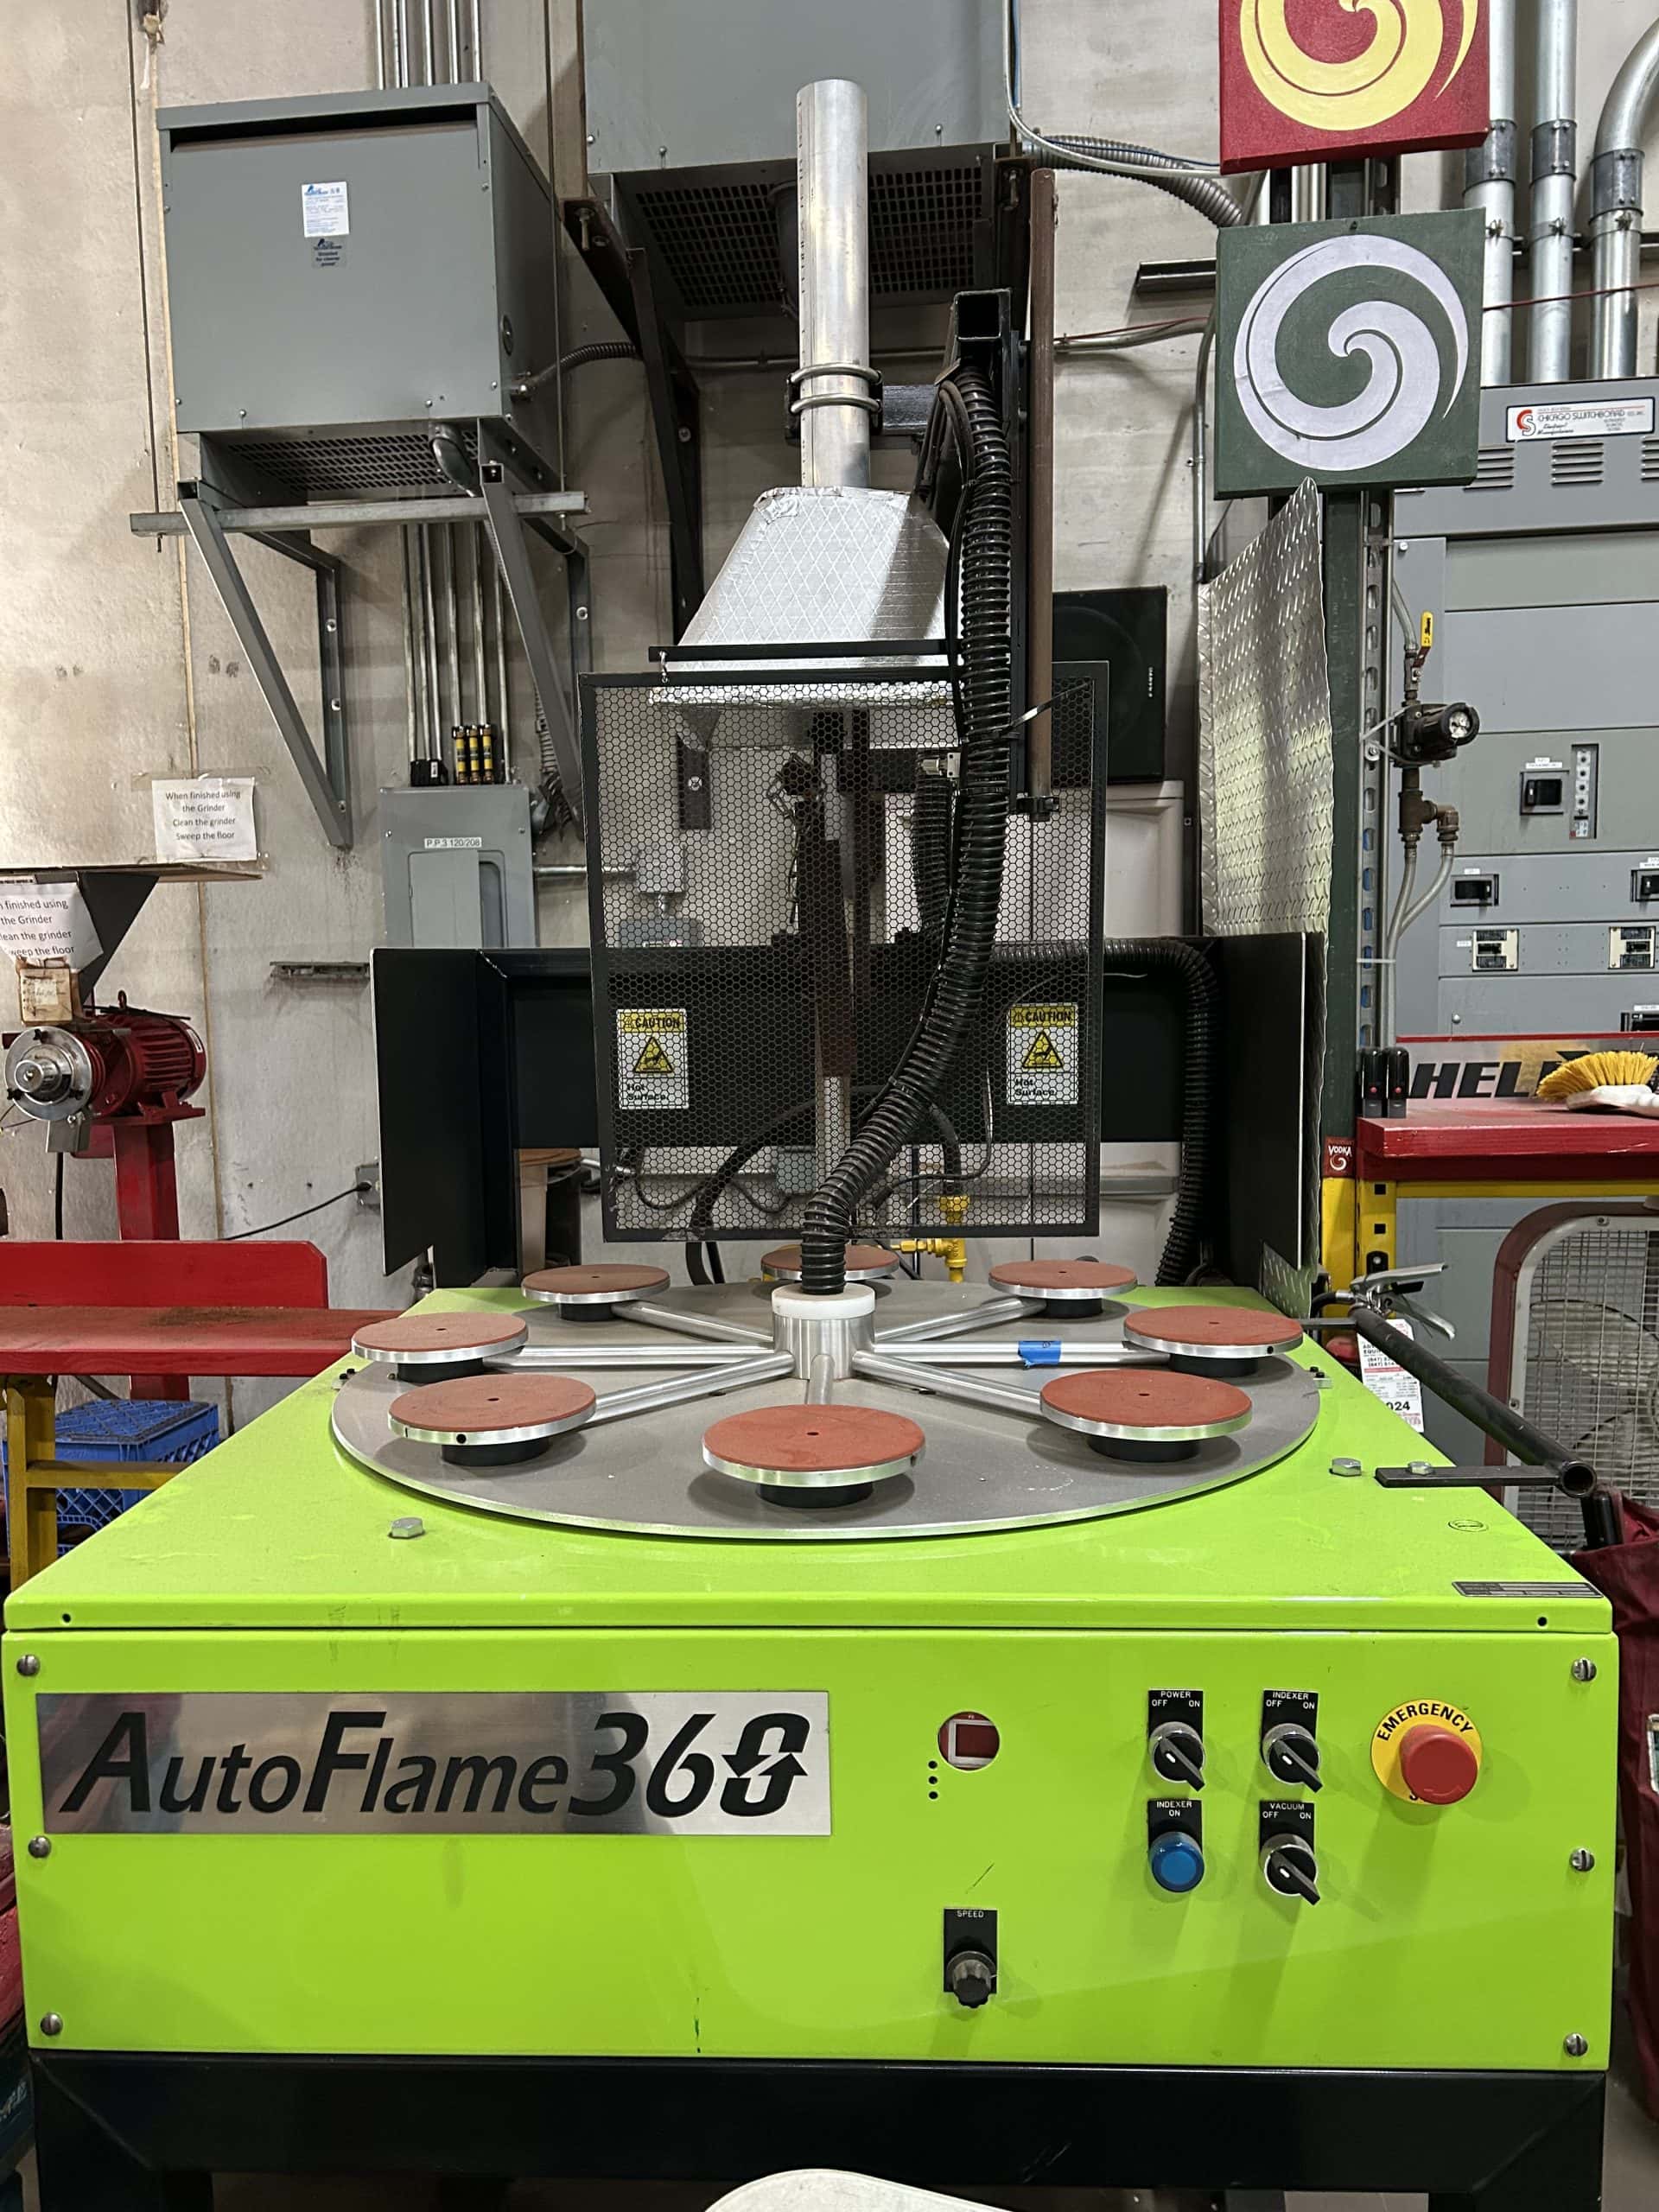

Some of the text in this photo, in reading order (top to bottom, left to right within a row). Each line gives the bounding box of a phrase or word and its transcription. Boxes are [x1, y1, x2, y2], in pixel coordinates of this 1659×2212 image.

[190, 791, 220, 799] finished
[221, 790, 241, 800] using
[182, 804, 226, 813] the Grinder
[210, 817, 236, 827] grinder
[4, 899, 41, 910] finished
[42, 899, 69, 910] using
[1, 915, 53, 925] the Grinder
[21, 931, 36, 941] the
[38, 930, 72, 942] grinder
[35, 947, 51, 956] the
[52, 945, 75, 955] floor
[1025, 1011, 1071, 1022] CAUTION
[635, 1017, 681, 1028] CAUTION
[1328, 1145, 1352, 1157] VODKA
[1160, 1690, 1192, 1699] POWER
[1272, 1691, 1309, 1700] INDEXER
[1266, 1699, 1315, 1710] OFF ON
[1376, 1702, 1473, 1741] EMERGENCY
[1156, 1800, 1192, 1808] INDEXER
[1269, 1802, 1305, 1811] VACUUM
[1262, 1810, 1312, 1820] OFF ON
[957, 1910, 984, 1918] SPEED
